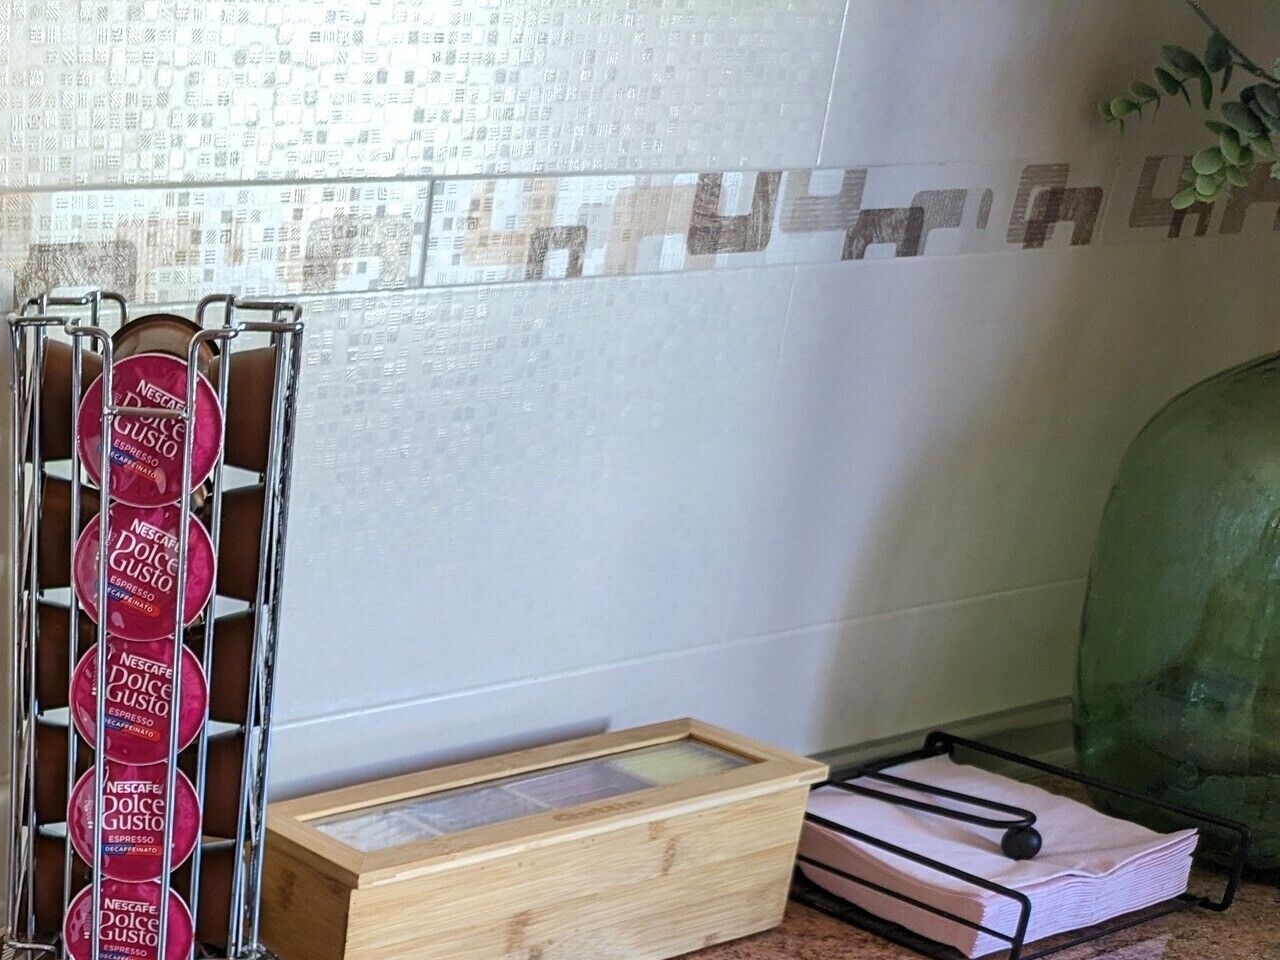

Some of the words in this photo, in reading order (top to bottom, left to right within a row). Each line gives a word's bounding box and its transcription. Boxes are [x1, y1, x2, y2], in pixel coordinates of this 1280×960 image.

[113, 415, 178, 458] Gusto
[109, 451, 158, 479] ECAFFEINATO
[114, 439, 159, 467] ESPRESSO
[115, 529, 179, 576] Dolce
[109, 549, 173, 593] Gusto
[107, 587, 154, 613] ECAFFEINATO
[110, 575, 155, 601] ESPRESSO
[109, 664, 172, 701] Dolce
[106, 682, 169, 716] Gusto
[108, 707, 154, 727] ESPRESSO
[102, 794, 165, 815] Dolce
[102, 812, 164, 832] Gusto
[104, 846, 158, 854] DECAFFEINATO
[108, 835, 154, 844] ESPRESSO
[99, 911, 160, 932] Dolce
[99, 928, 159, 947] Gusto
[103, 944, 148, 956] ESPRESSO
